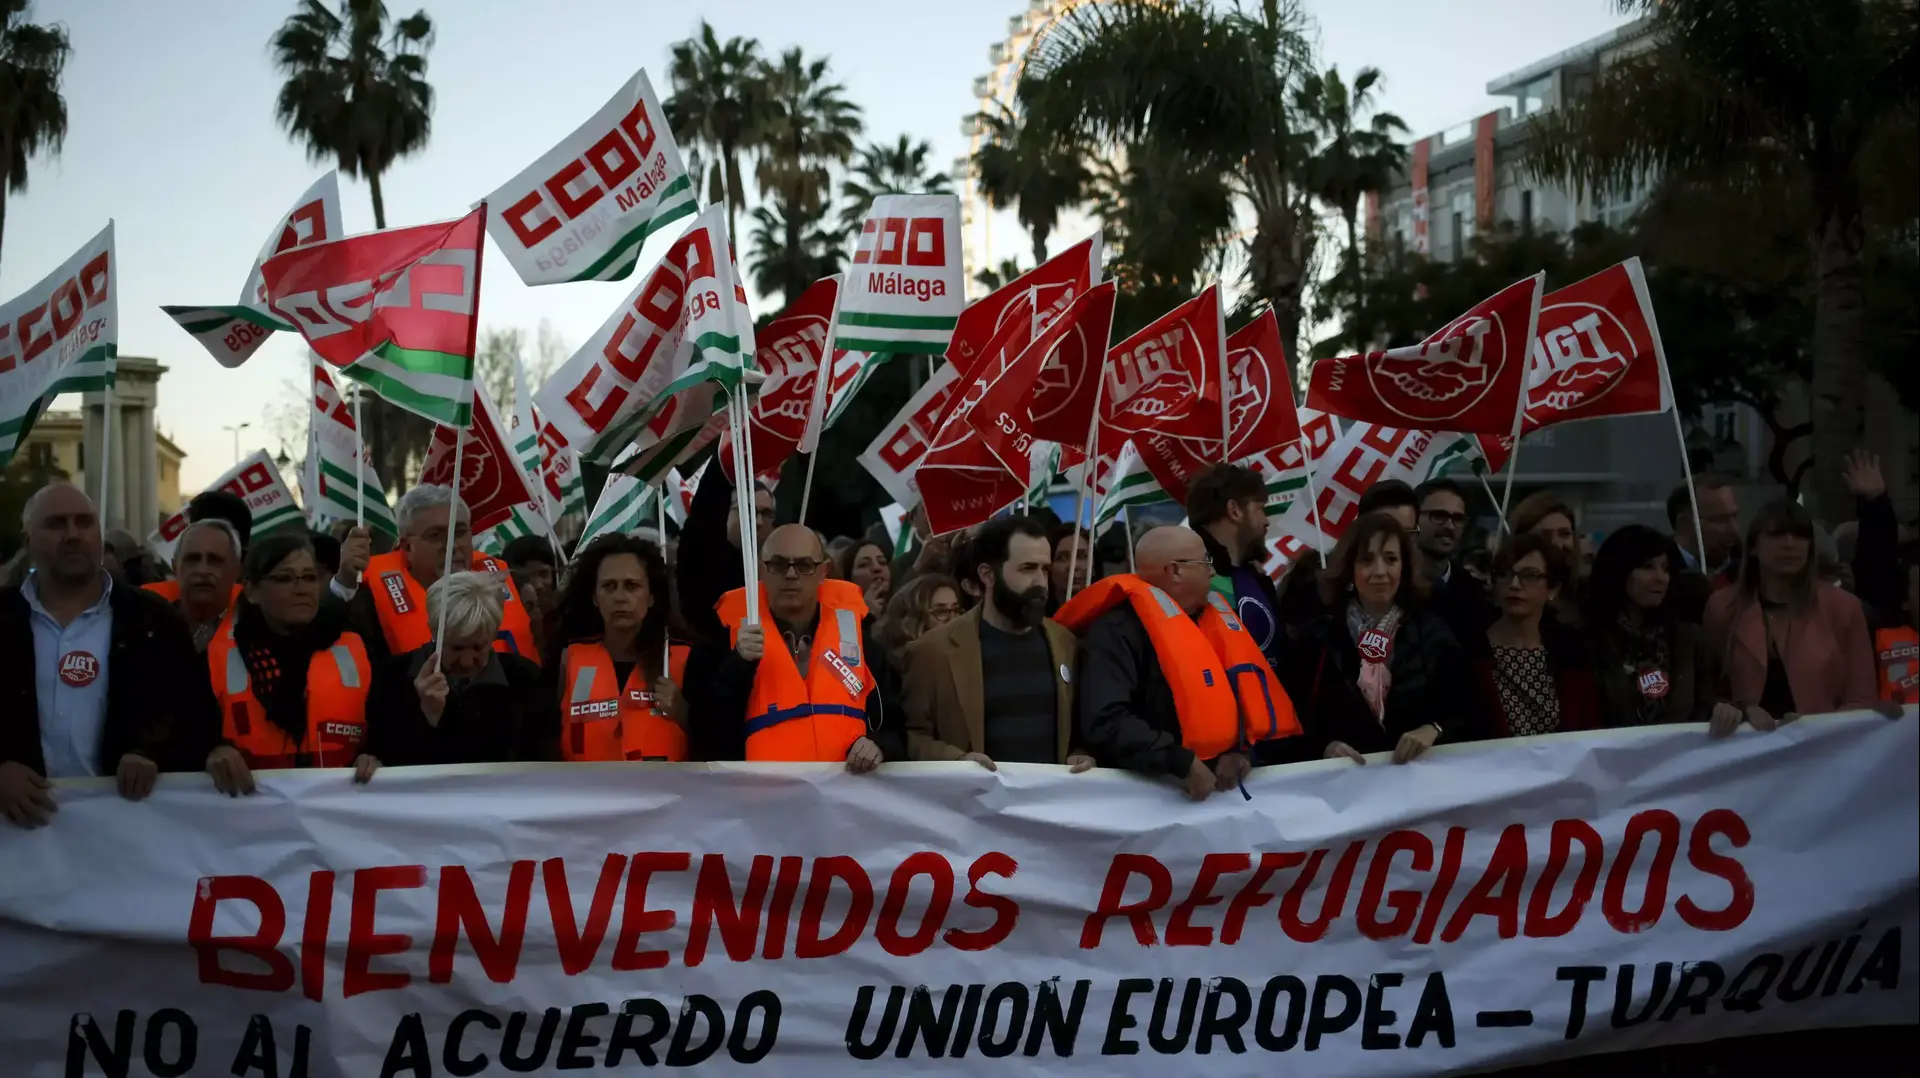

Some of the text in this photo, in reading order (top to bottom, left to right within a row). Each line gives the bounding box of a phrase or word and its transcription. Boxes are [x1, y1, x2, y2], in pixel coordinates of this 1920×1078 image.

[502, 98, 657, 249] CCOO
[615, 151, 667, 212] Málaga
[868, 271, 946, 301] Málaga
[565, 227, 716, 434] CCOO
[1106, 328, 1186, 407] UGT
[63, 655, 96, 673] UGT
[1361, 631, 1390, 652] UGT
[824, 650, 858, 688] CCOO
[1640, 670, 1664, 691] UGT
[571, 701, 610, 716] CCOO
[187, 808, 1756, 1002] BIENVENIDOS REFUGIADOS
[65, 1008, 198, 1078] NO
[378, 988, 782, 1078] ACUERDO
[845, 975, 1092, 1060] UNION
[1101, 974, 1456, 1051] EUROPEA
[1556, 919, 1903, 1040] TURQUÍA
